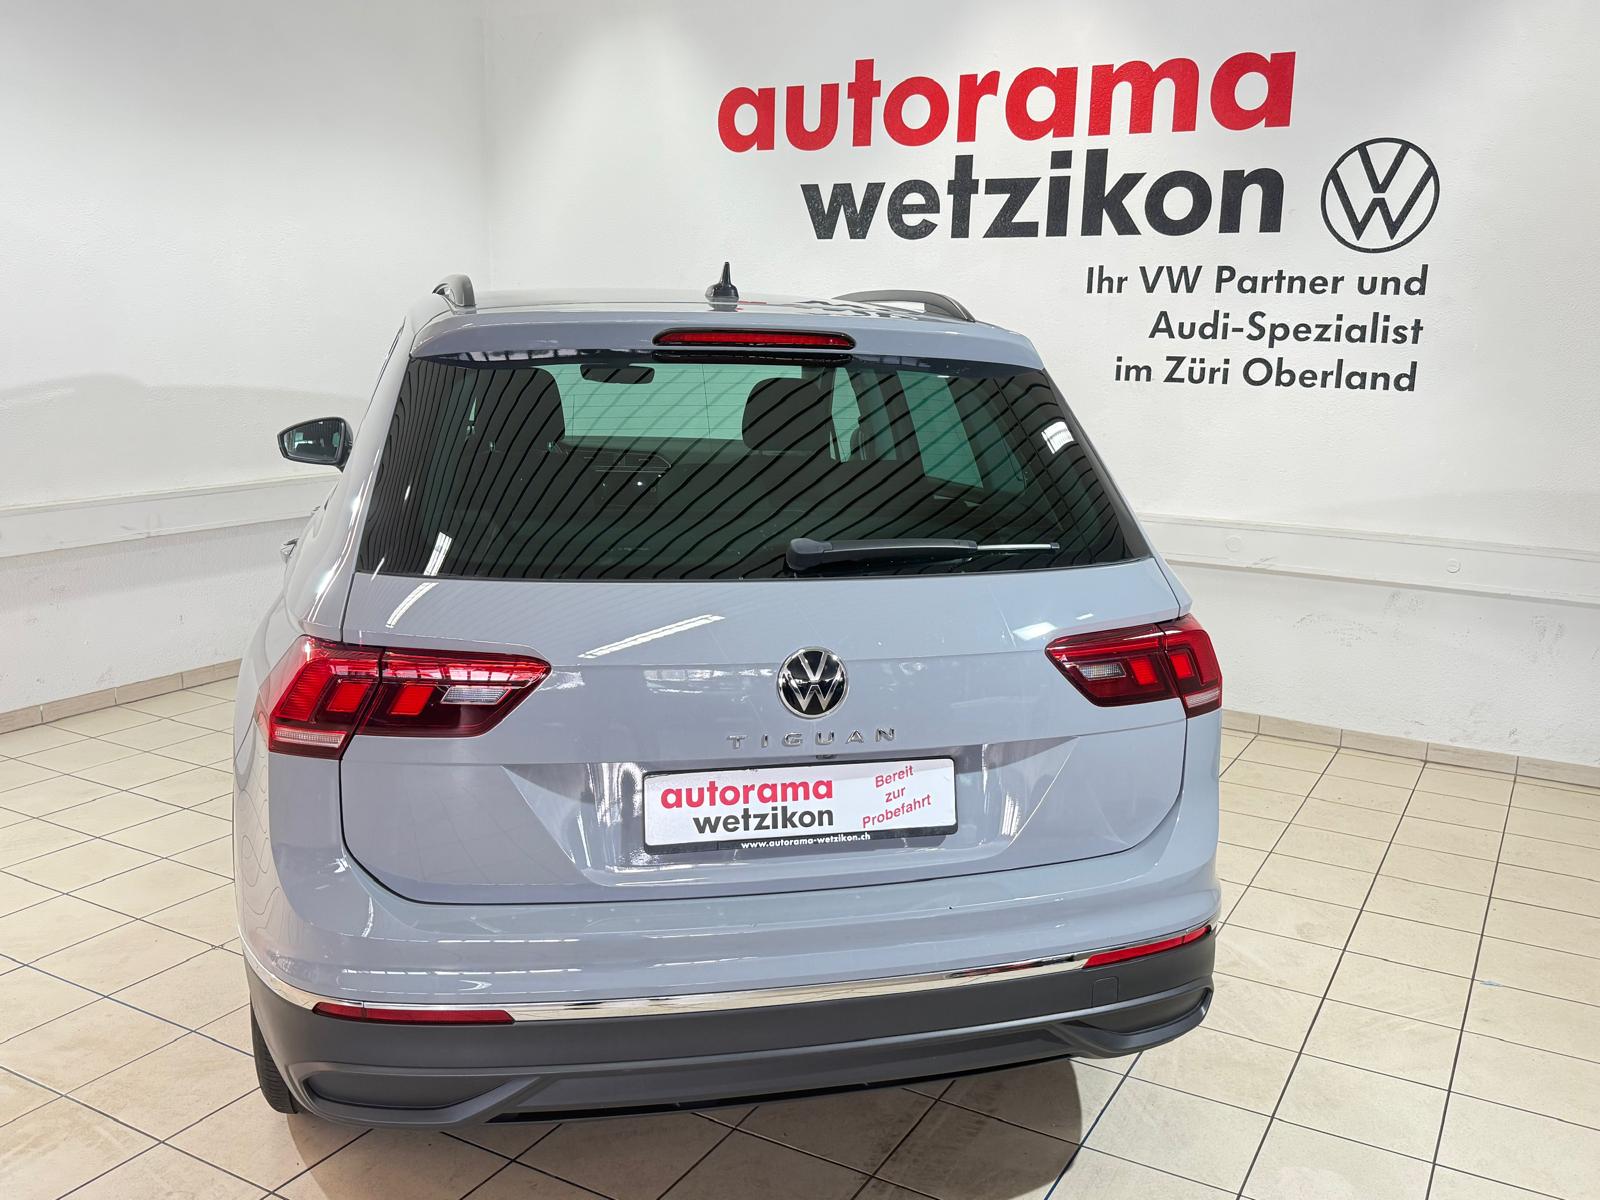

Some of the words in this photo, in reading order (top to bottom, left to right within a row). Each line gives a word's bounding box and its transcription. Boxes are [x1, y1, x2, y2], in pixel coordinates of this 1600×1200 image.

[717, 51, 1296, 152] autorama
[801, 149, 1285, 239] wetzikon
[1086, 265, 1128, 294] Ihr
[1139, 266, 1202, 294] VW
[1214, 265, 1345, 294] Partner
[1356, 264, 1428, 295] und
[1149, 310, 1424, 347] Audi-Spezialist
[1115, 356, 1153, 383] im
[1163, 356, 1230, 385] Züri
[1242, 357, 1418, 392] Oberland
[727, 727, 896, 749] TIGUAN
[874, 765, 914, 788] Bereit
[661, 780, 833, 809] autorama
[885, 785, 907, 803] zur
[693, 806, 834, 834] wetzikon
[862, 794, 932, 828] Probefahrt
[741, 832, 871, 850] www.autorama-wetzikon.ch
